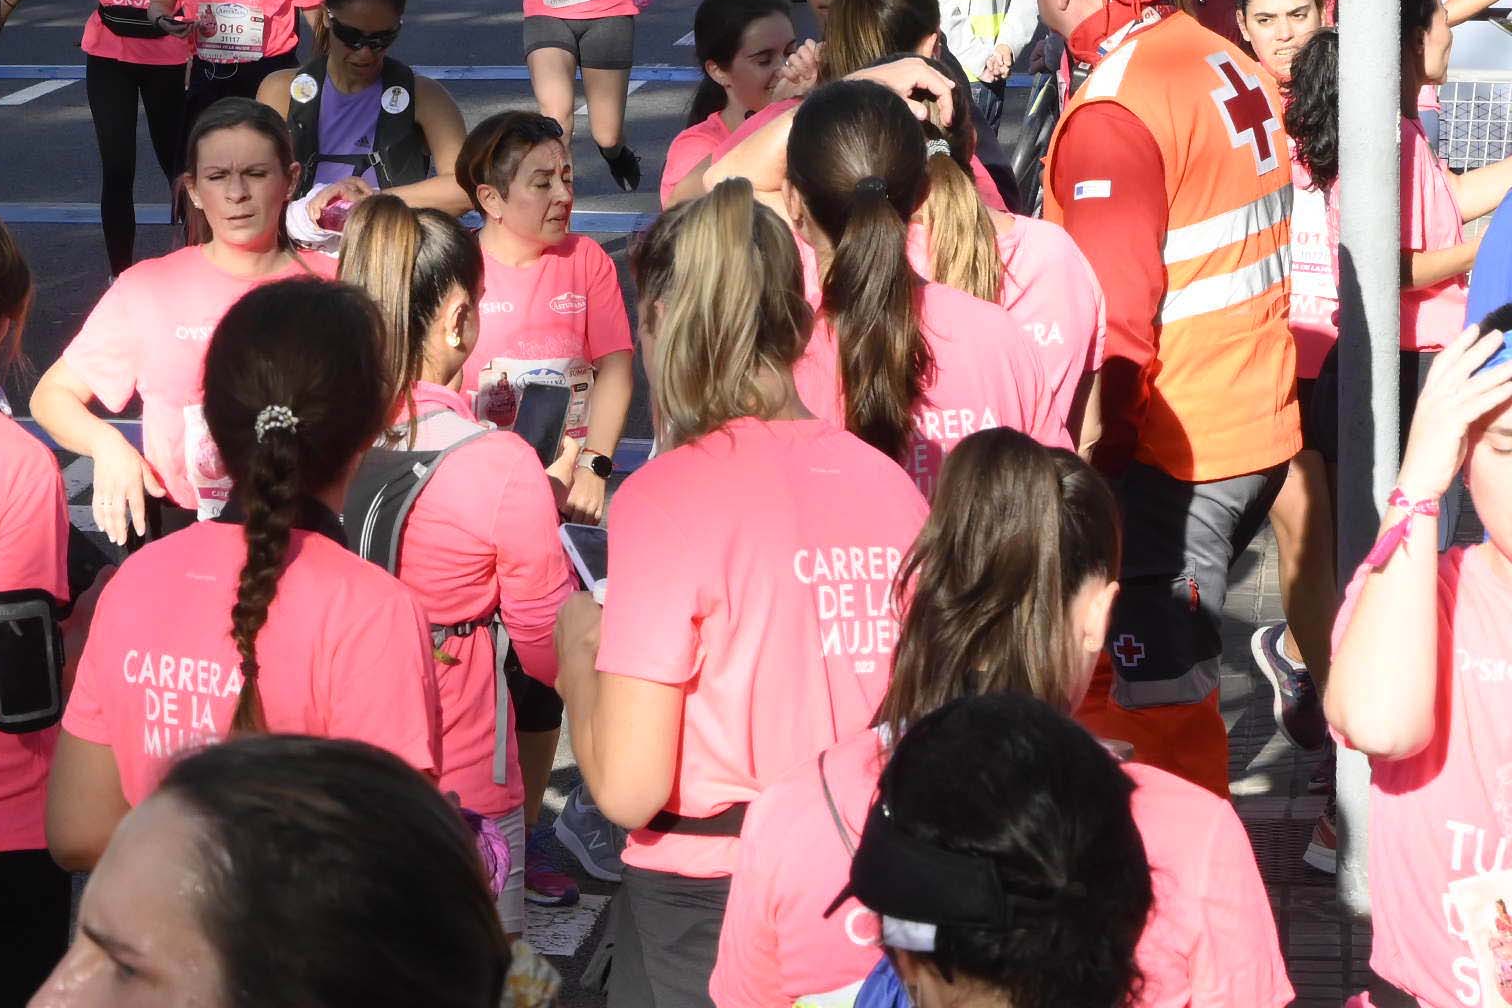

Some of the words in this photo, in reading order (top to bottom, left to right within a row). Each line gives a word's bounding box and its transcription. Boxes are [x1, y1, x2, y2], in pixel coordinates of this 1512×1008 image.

[219, 23, 244, 34] 016
[481, 301, 513, 313] SHO
[175, 325, 215, 341] OYS
[793, 548, 903, 584] CARRER
[818, 584, 854, 620] DE
[868, 587, 901, 619] LA
[123, 649, 243, 697] CARRERA
[145, 688, 178, 725] DE
[191, 697, 216, 730] LA
